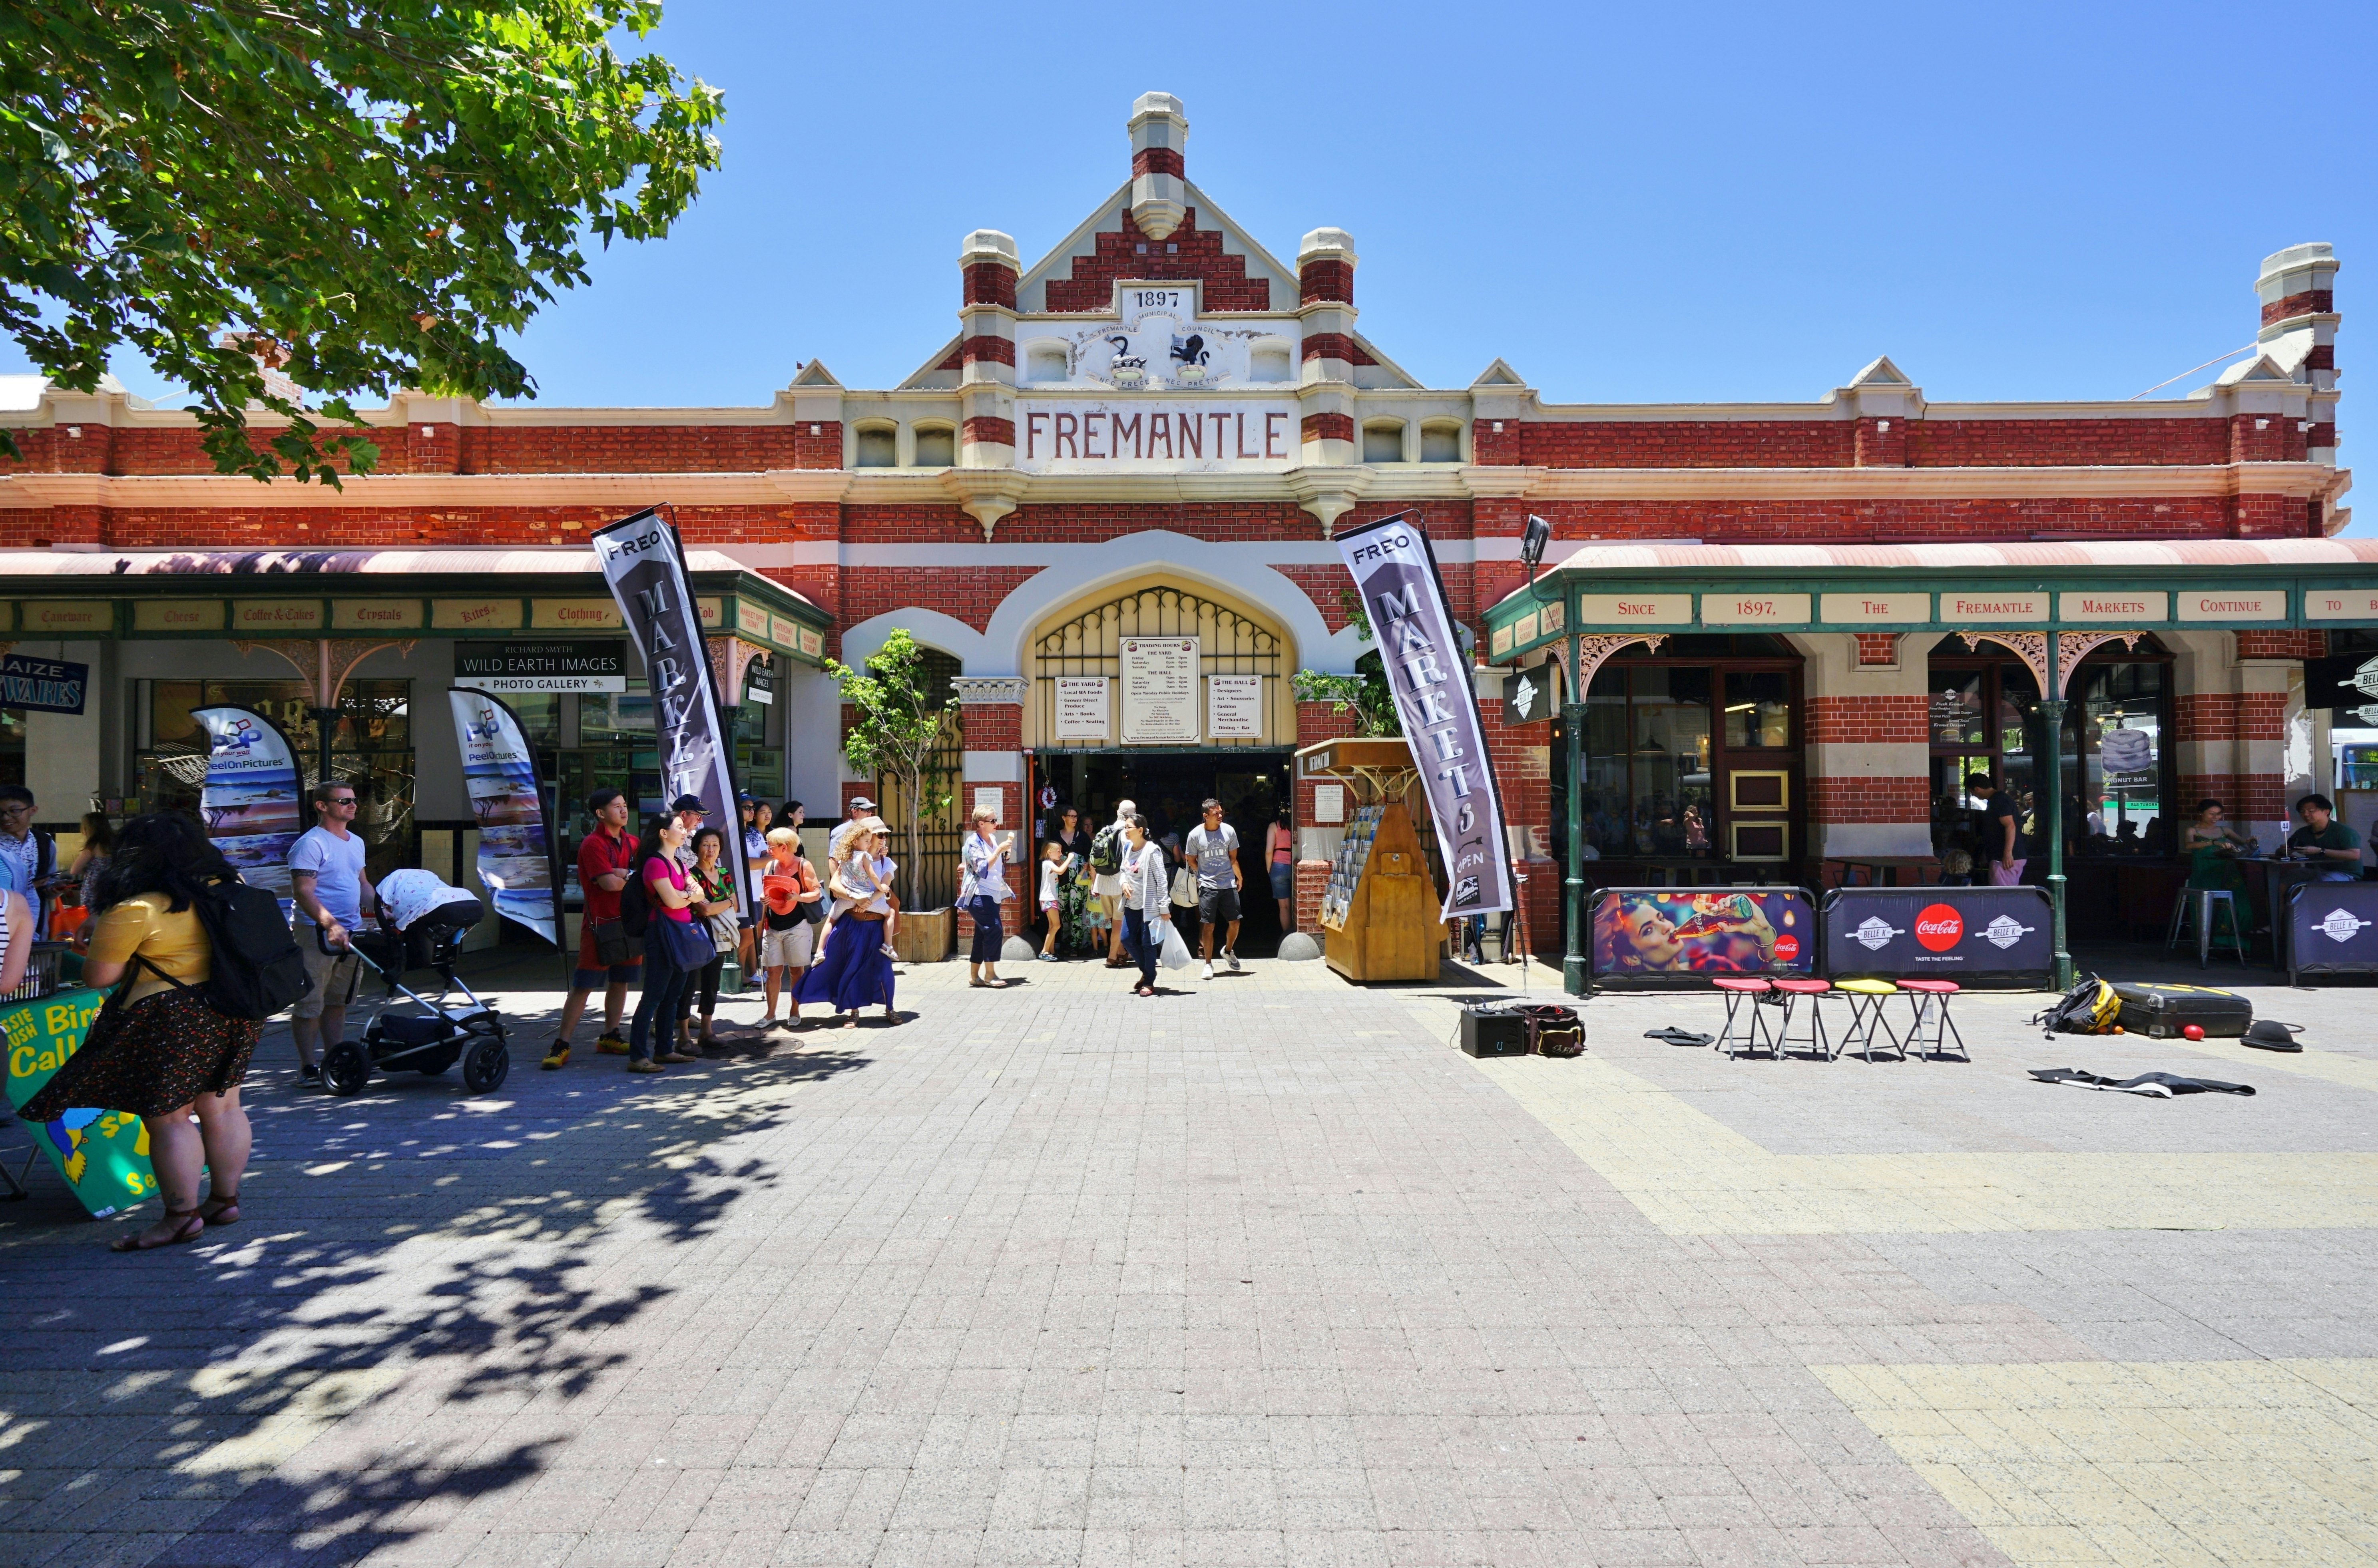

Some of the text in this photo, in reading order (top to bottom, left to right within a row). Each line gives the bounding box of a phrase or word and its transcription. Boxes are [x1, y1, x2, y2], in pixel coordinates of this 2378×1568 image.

[1137, 291, 1179, 308] 1897
[1138, 310, 1177, 320] MUNICIPAL
[1098, 325, 1137, 336] FREMANTLE
[1099, 377, 1115, 386] NEC
[1188, 376, 1219, 387] PRETIO
[1027, 413, 1288, 459] FREMANTLE
[607, 531, 660, 561] FREO
[1352, 535, 1409, 565] FREO
[1545, 606, 1561, 619] HOLIDAY
[1737, 600, 1776, 616] 1897,
[2326, 601, 2341, 611] TO
[42, 610, 93, 622] Caneware
[164, 611, 199, 623] Cheese
[243, 609, 315, 621] Coffee & Cakes
[357, 609, 402, 620] Crystals
[558, 608, 602, 621] Clothing
[740, 607, 765, 623] MARKET OPEN
[746, 619, 759, 630] FRIDAY
[774, 622, 793, 635] SATURDAY
[1518, 618, 1535, 633] SATURDAY
[1545, 616, 1561, 631] MONDAY
[776, 632, 791, 645] SUNDAY
[803, 634, 817, 645] HOLIDAY
[1520, 629, 1533, 642] SUNDAY
[804, 643, 817, 654] MONDAY
[0, 660, 64, 678] AIZE
[464, 658, 617, 671] WILD EARTH IMAGES
[752, 665, 773, 678] WILD EARTH
[494, 679, 588, 688] PHOTO GALLERY
[755, 677, 769, 688] IMAGES
[0, 675, 80, 708] WARES
[209, 758, 285, 770] eelOnPictures
[1309, 751, 1330, 772] INFORMATION
[1204, 838, 1218, 850] QUALITY
[1457, 852, 1484, 874] OPEN
[1458, 891, 1478, 906] MARKETS
[1917, 920, 1960, 935] Coca-Cola
[2330, 921, 2346, 930] BELLE
[1864, 929, 1880, 938] BELLE
[1993, 928, 2009, 937] BELLE
[1775, 943, 1798, 951] Coca-Cola
